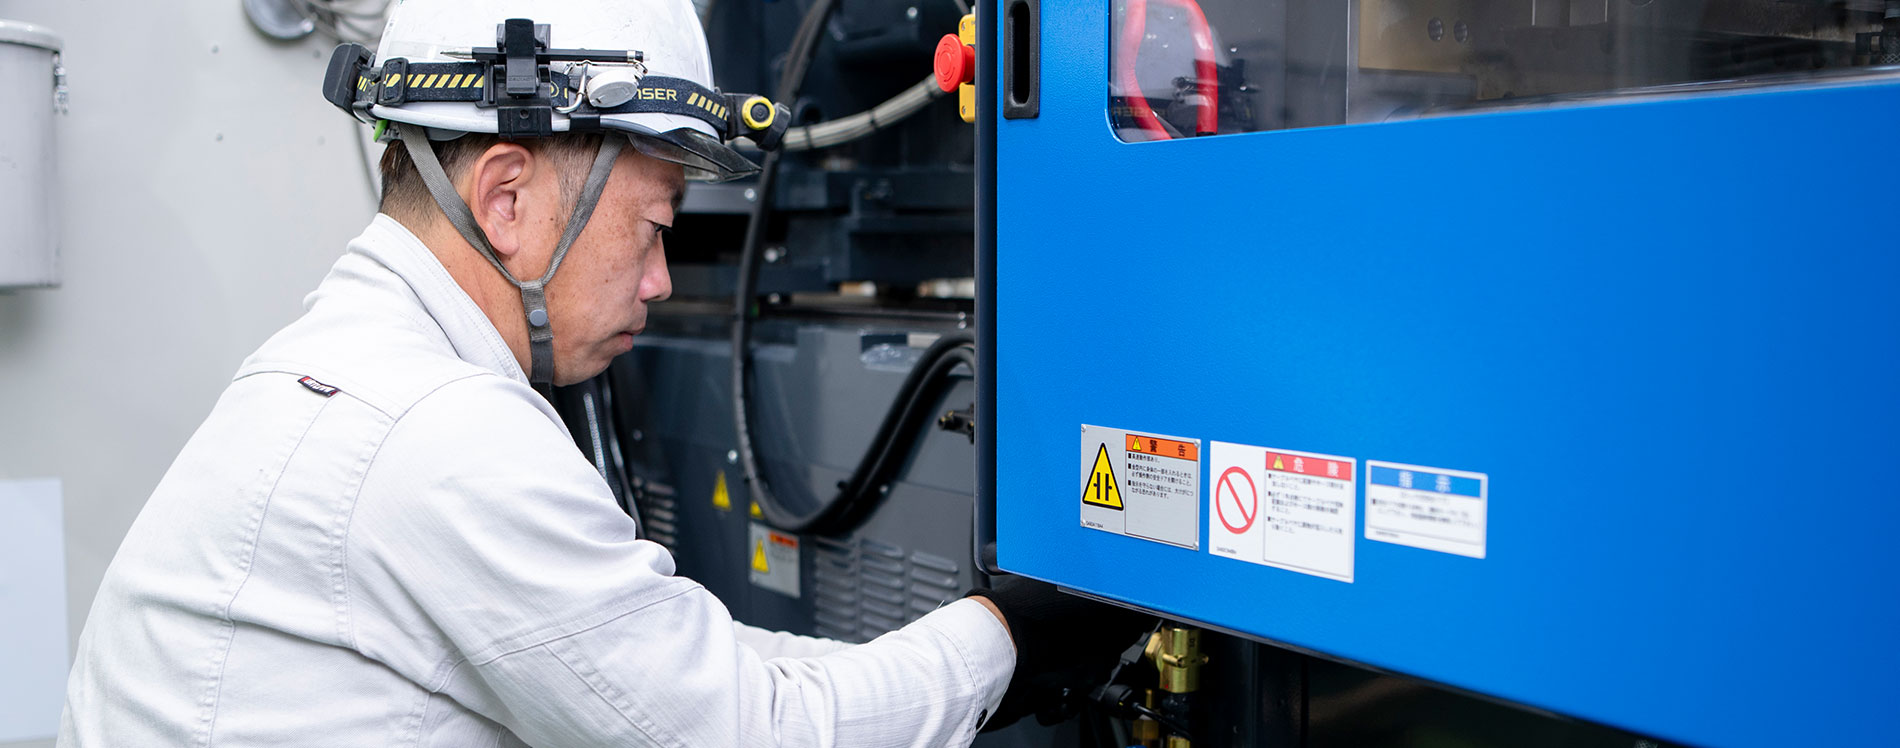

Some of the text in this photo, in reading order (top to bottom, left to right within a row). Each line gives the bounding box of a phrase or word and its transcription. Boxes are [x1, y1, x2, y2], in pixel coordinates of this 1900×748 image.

[1149, 439, 1186, 457] 警告
[1293, 457, 1339, 477] 危険
[1398, 470, 1451, 493] 指示
